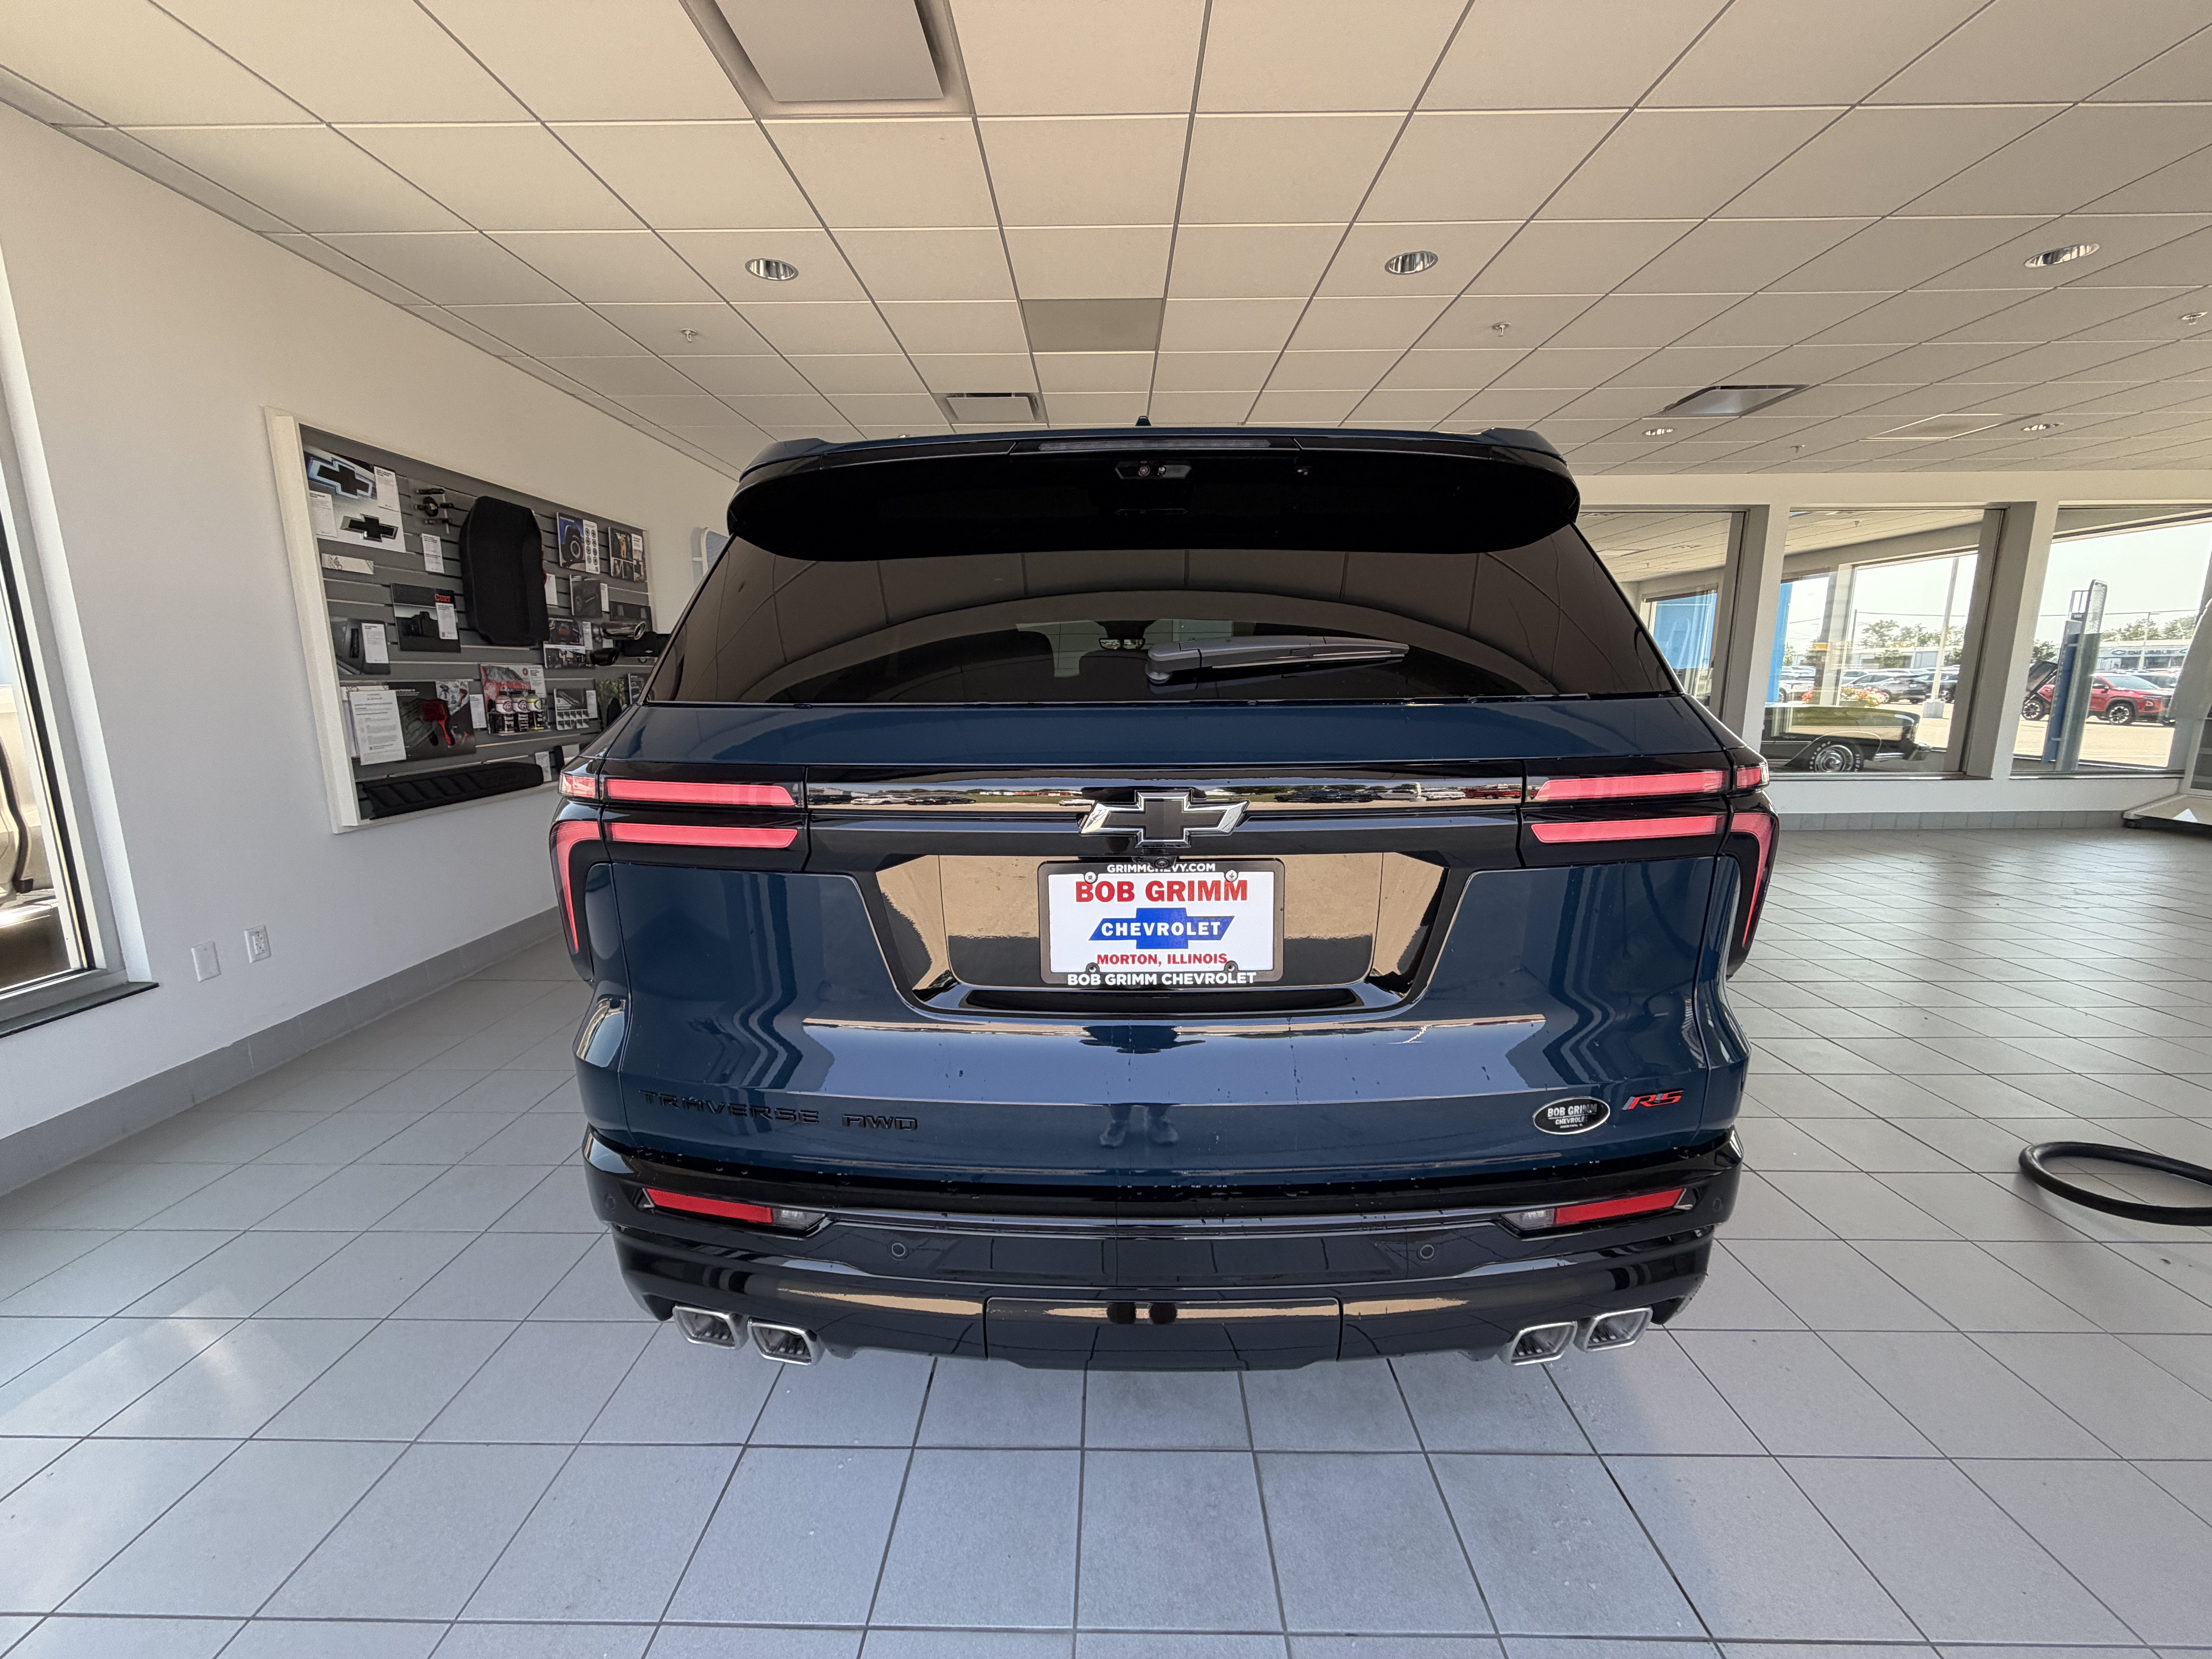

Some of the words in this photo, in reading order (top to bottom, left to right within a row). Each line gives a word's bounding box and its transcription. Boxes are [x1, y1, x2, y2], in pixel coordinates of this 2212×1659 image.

[1107, 863, 1215, 873] GRIMMCVY.COM
[1075, 881, 1135, 902] BOB
[1146, 879, 1247, 902] GRIMM
[1101, 921, 1221, 936] CHEVROLET
[1097, 954, 1161, 967] MORTON,
[1167, 953, 1228, 964] ILLINOIS
[1068, 973, 1101, 985] BOB
[1105, 973, 1157, 985] GRIMM
[1161, 972, 1257, 984] CHEVROLET
[1622, 1090, 1684, 1110] RS
[638, 1089, 819, 1123] TRAVERSE
[842, 1113, 918, 1130] AWD
[1547, 1107, 1566, 1117] BOB
